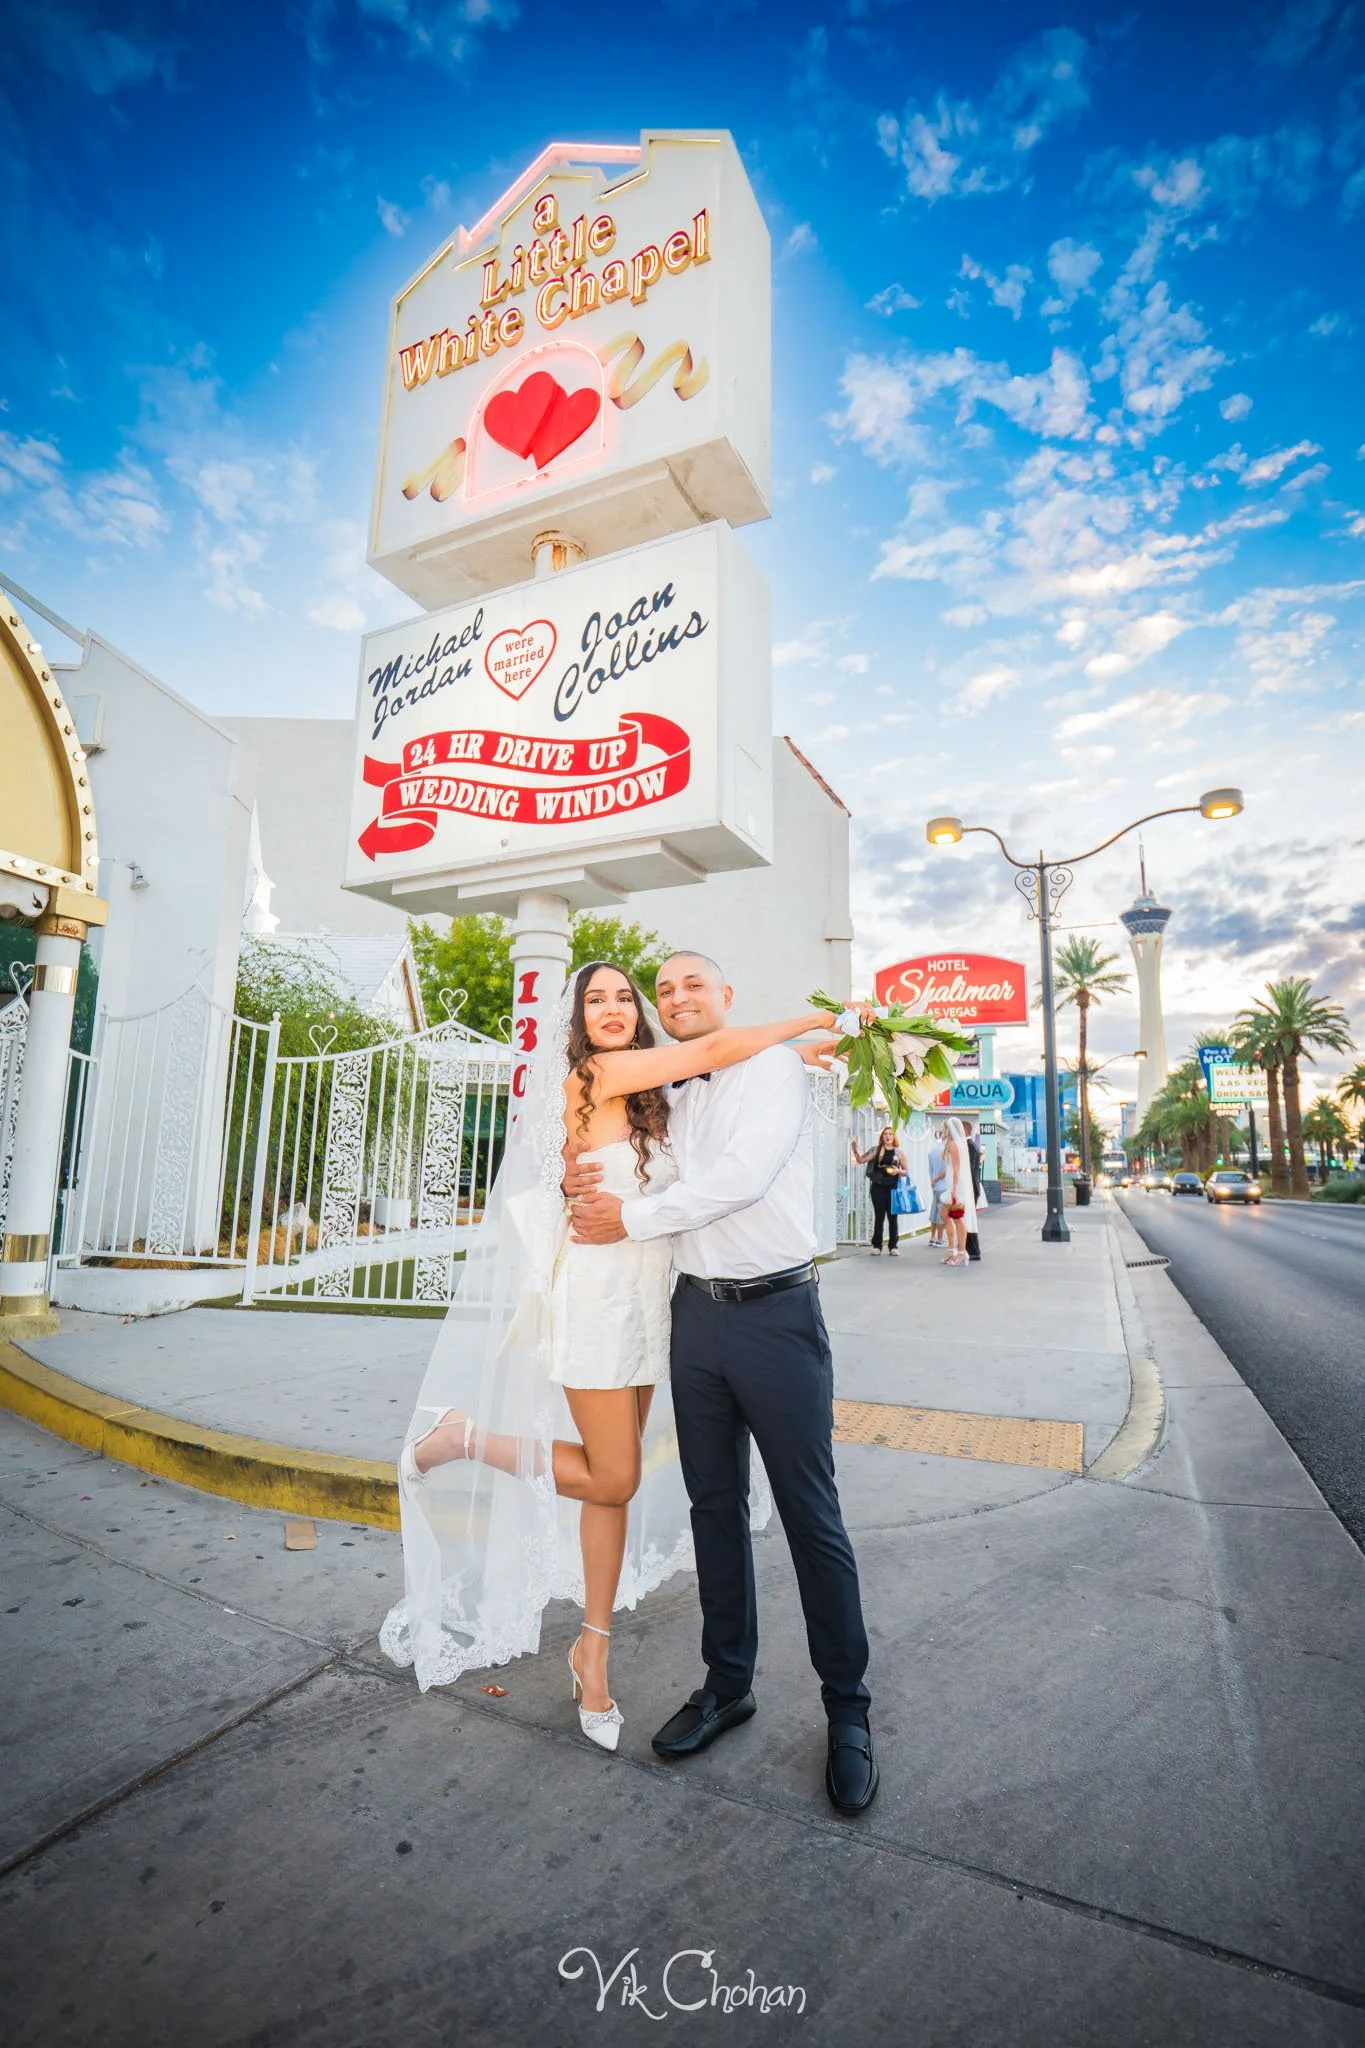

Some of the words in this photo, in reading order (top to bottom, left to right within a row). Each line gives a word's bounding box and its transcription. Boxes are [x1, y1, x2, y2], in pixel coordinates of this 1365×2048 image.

[533, 193, 559, 235] a
[479, 213, 617, 309] Little
[399, 307, 526, 391] White
[536, 208, 712, 331] Chapel
[504, 634, 535, 653] were
[581, 581, 677, 673] Joan
[367, 607, 484, 698] Michael
[493, 645, 545, 672] married
[553, 610, 710, 722] Collins
[504, 665, 533, 684] here
[371, 656, 473, 741] Jordan
[409, 740, 436, 768] 24
[447, 732, 483, 760] HR
[492, 740, 575, 772] DRIVE
[588, 737, 628, 769] UP
[399, 778, 520, 820] WEDDING
[535, 766, 667, 820] WINDOW
[927, 958, 970, 972] HOTEL
[885, 968, 1016, 1007] Shalimar
[942, 1006, 977, 1018] VEGAS
[954, 1083, 1004, 1099] AQUA
